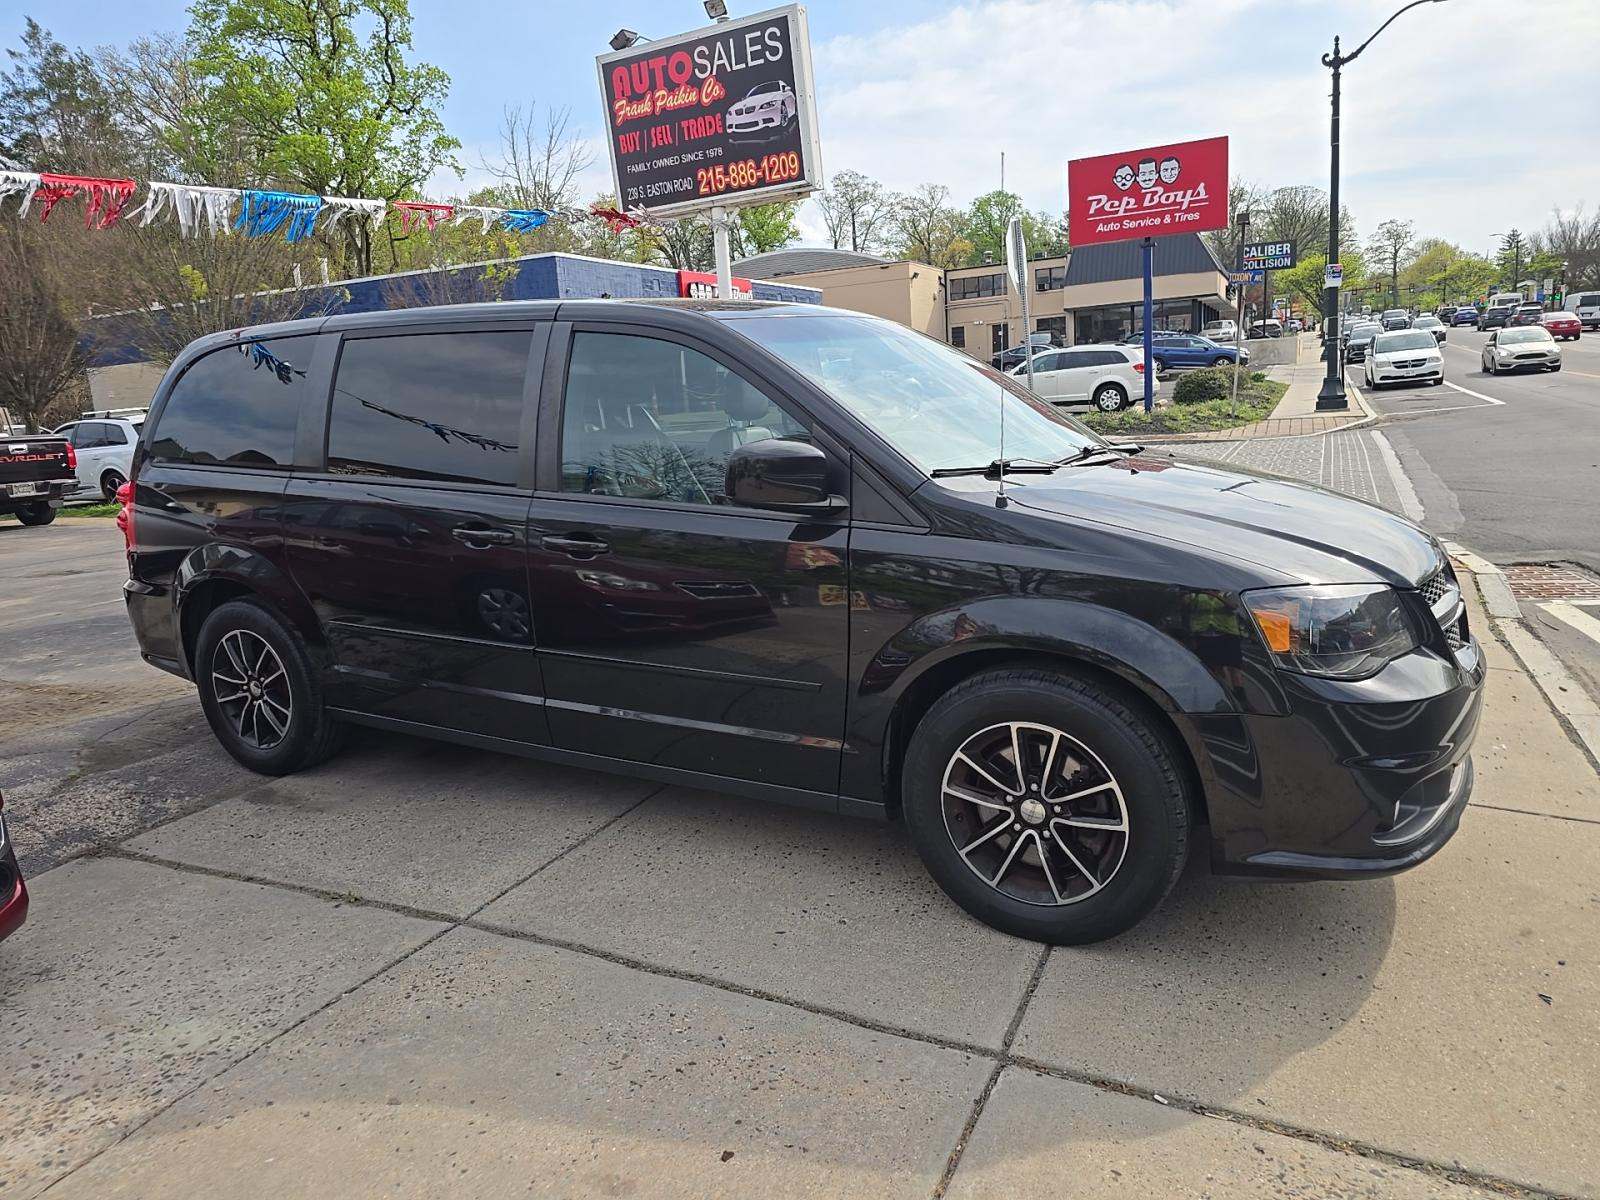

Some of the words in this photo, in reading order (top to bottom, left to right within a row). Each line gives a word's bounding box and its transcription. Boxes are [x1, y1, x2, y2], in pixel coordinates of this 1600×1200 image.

[612, 51, 693, 99] AUTO
[694, 26, 783, 79] SALES
[614, 92, 653, 126] Frank
[654, 84, 698, 114] Paikin
[618, 131, 641, 153] BUY
[650, 124, 673, 148] SELL
[681, 112, 724, 141] TRADE
[626, 161, 653, 174] FAMILY
[652, 155, 680, 169] OWNED
[681, 150, 704, 163] SINCE
[638, 187, 647, 199] S.
[647, 181, 674, 197] EASTON
[673, 177, 694, 192] ROAD
[698, 152, 799, 194] 215-886-1209
[1086, 194, 1138, 216] Pep
[1141, 182, 1209, 211] Boys
[1096, 222, 1121, 233] Auto
[1122, 216, 1161, 230] Service
[1163, 214, 1171, 224] &
[1174, 211, 1200, 223] Tires
[1242, 257, 1291, 271] COLLISION
[1243, 243, 1291, 258] CALIBER
